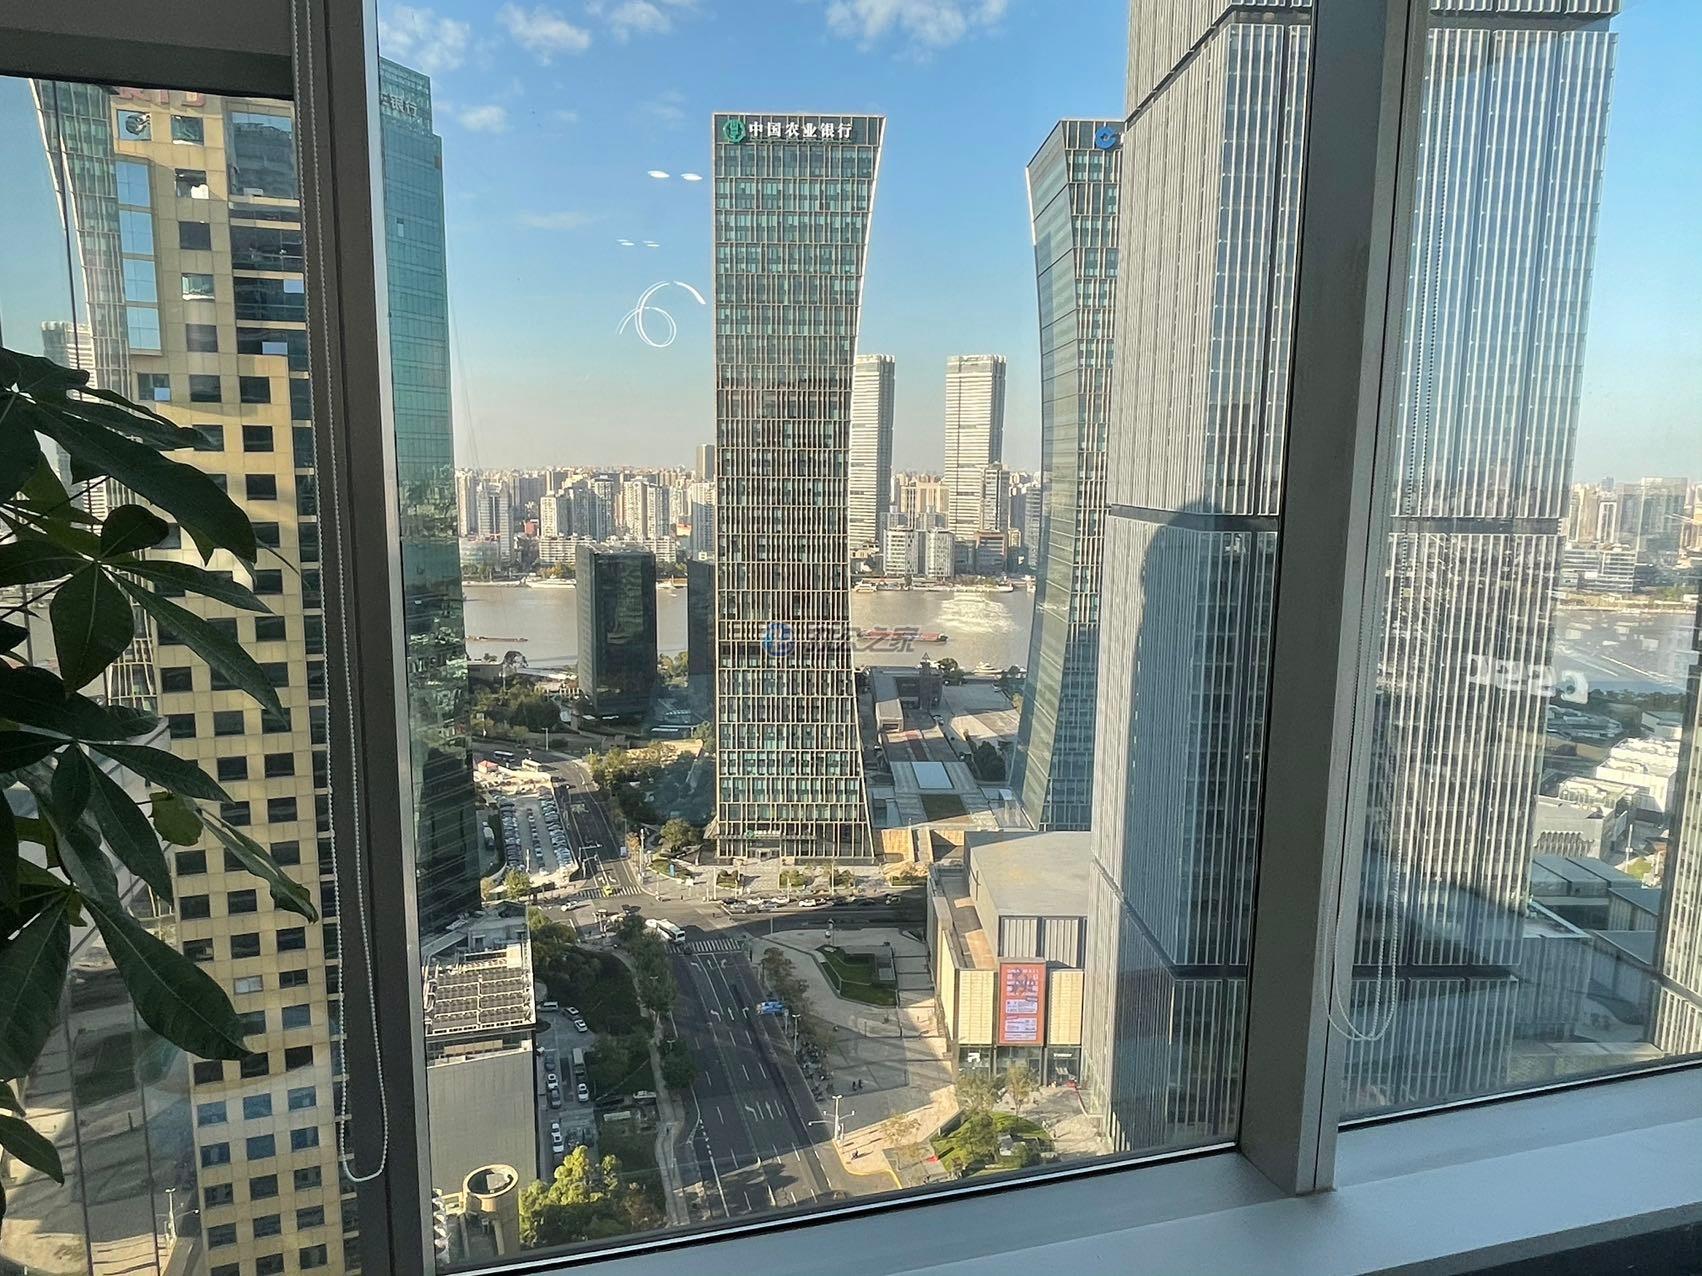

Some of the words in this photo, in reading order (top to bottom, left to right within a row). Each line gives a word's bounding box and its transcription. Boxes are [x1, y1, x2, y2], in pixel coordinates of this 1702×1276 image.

[749, 121, 852, 139] 中国农业银行
